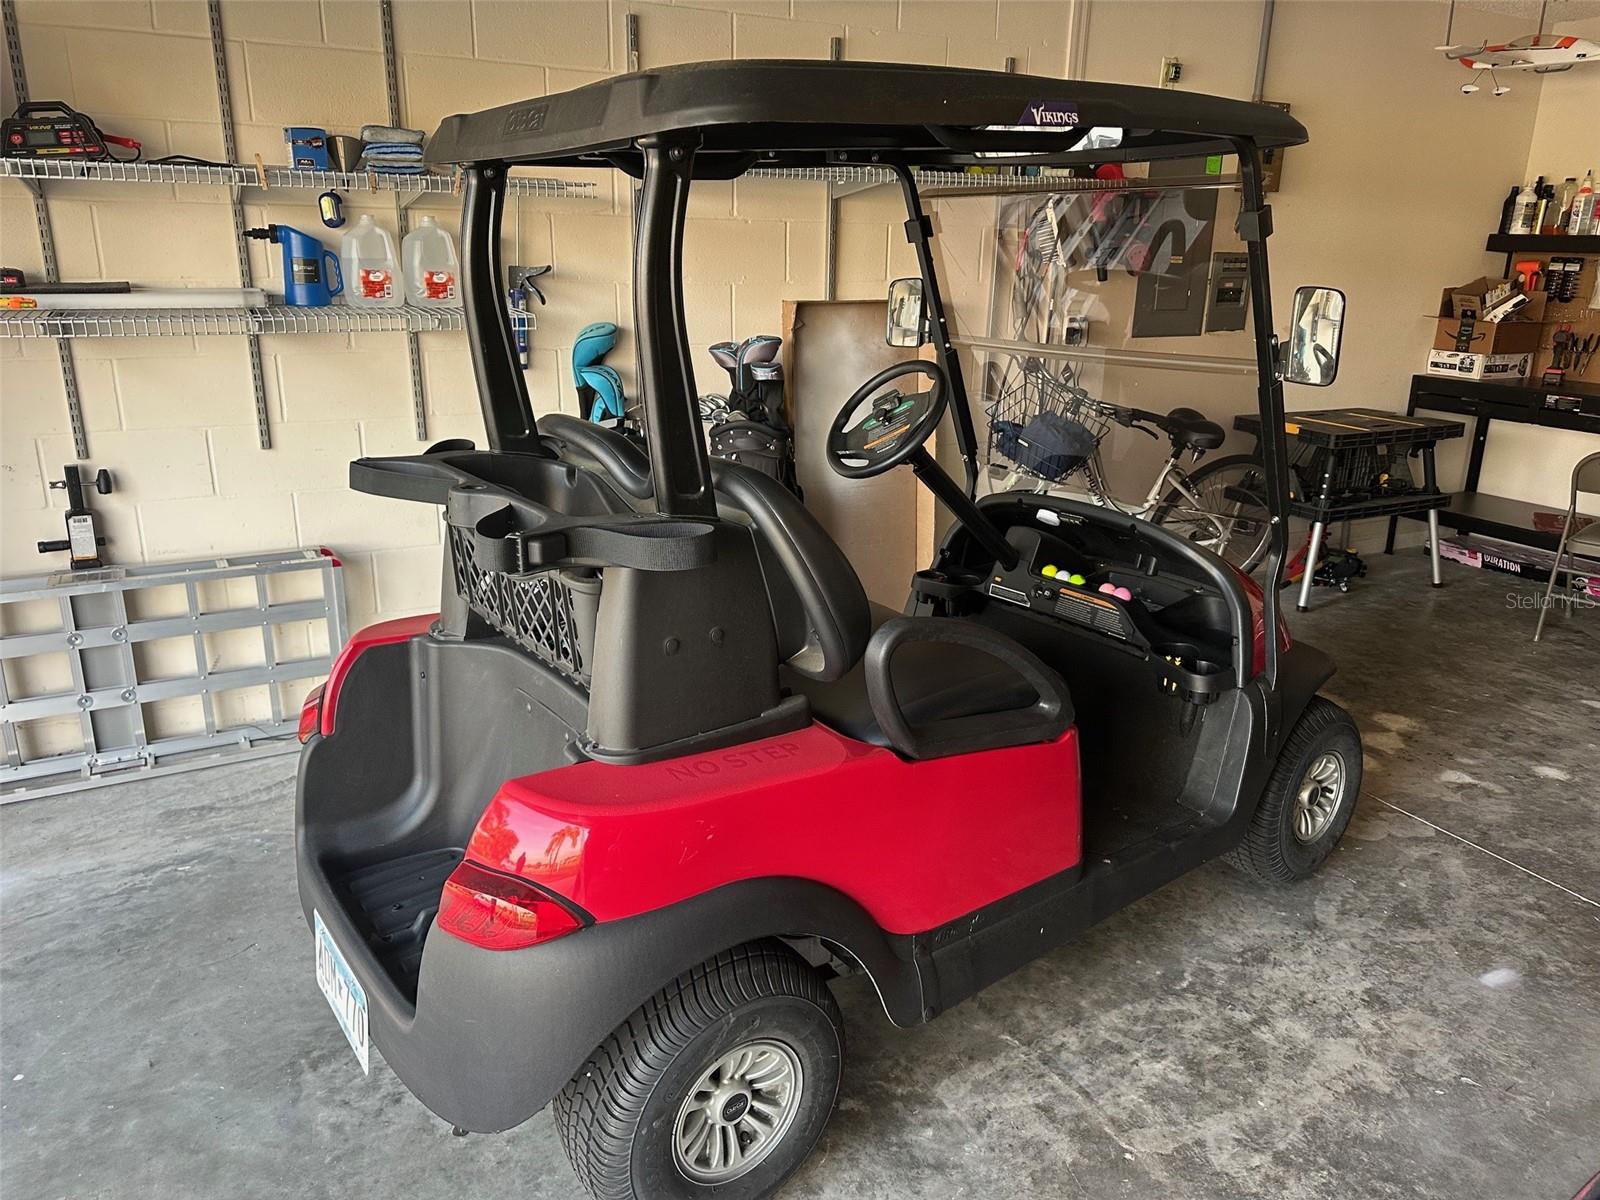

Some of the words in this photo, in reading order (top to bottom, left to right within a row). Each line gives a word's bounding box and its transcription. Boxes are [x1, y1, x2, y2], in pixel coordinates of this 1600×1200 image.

[664, 760, 721, 782] NO
[722, 742, 800, 769] STEP
[344, 979, 365, 1048] 770
